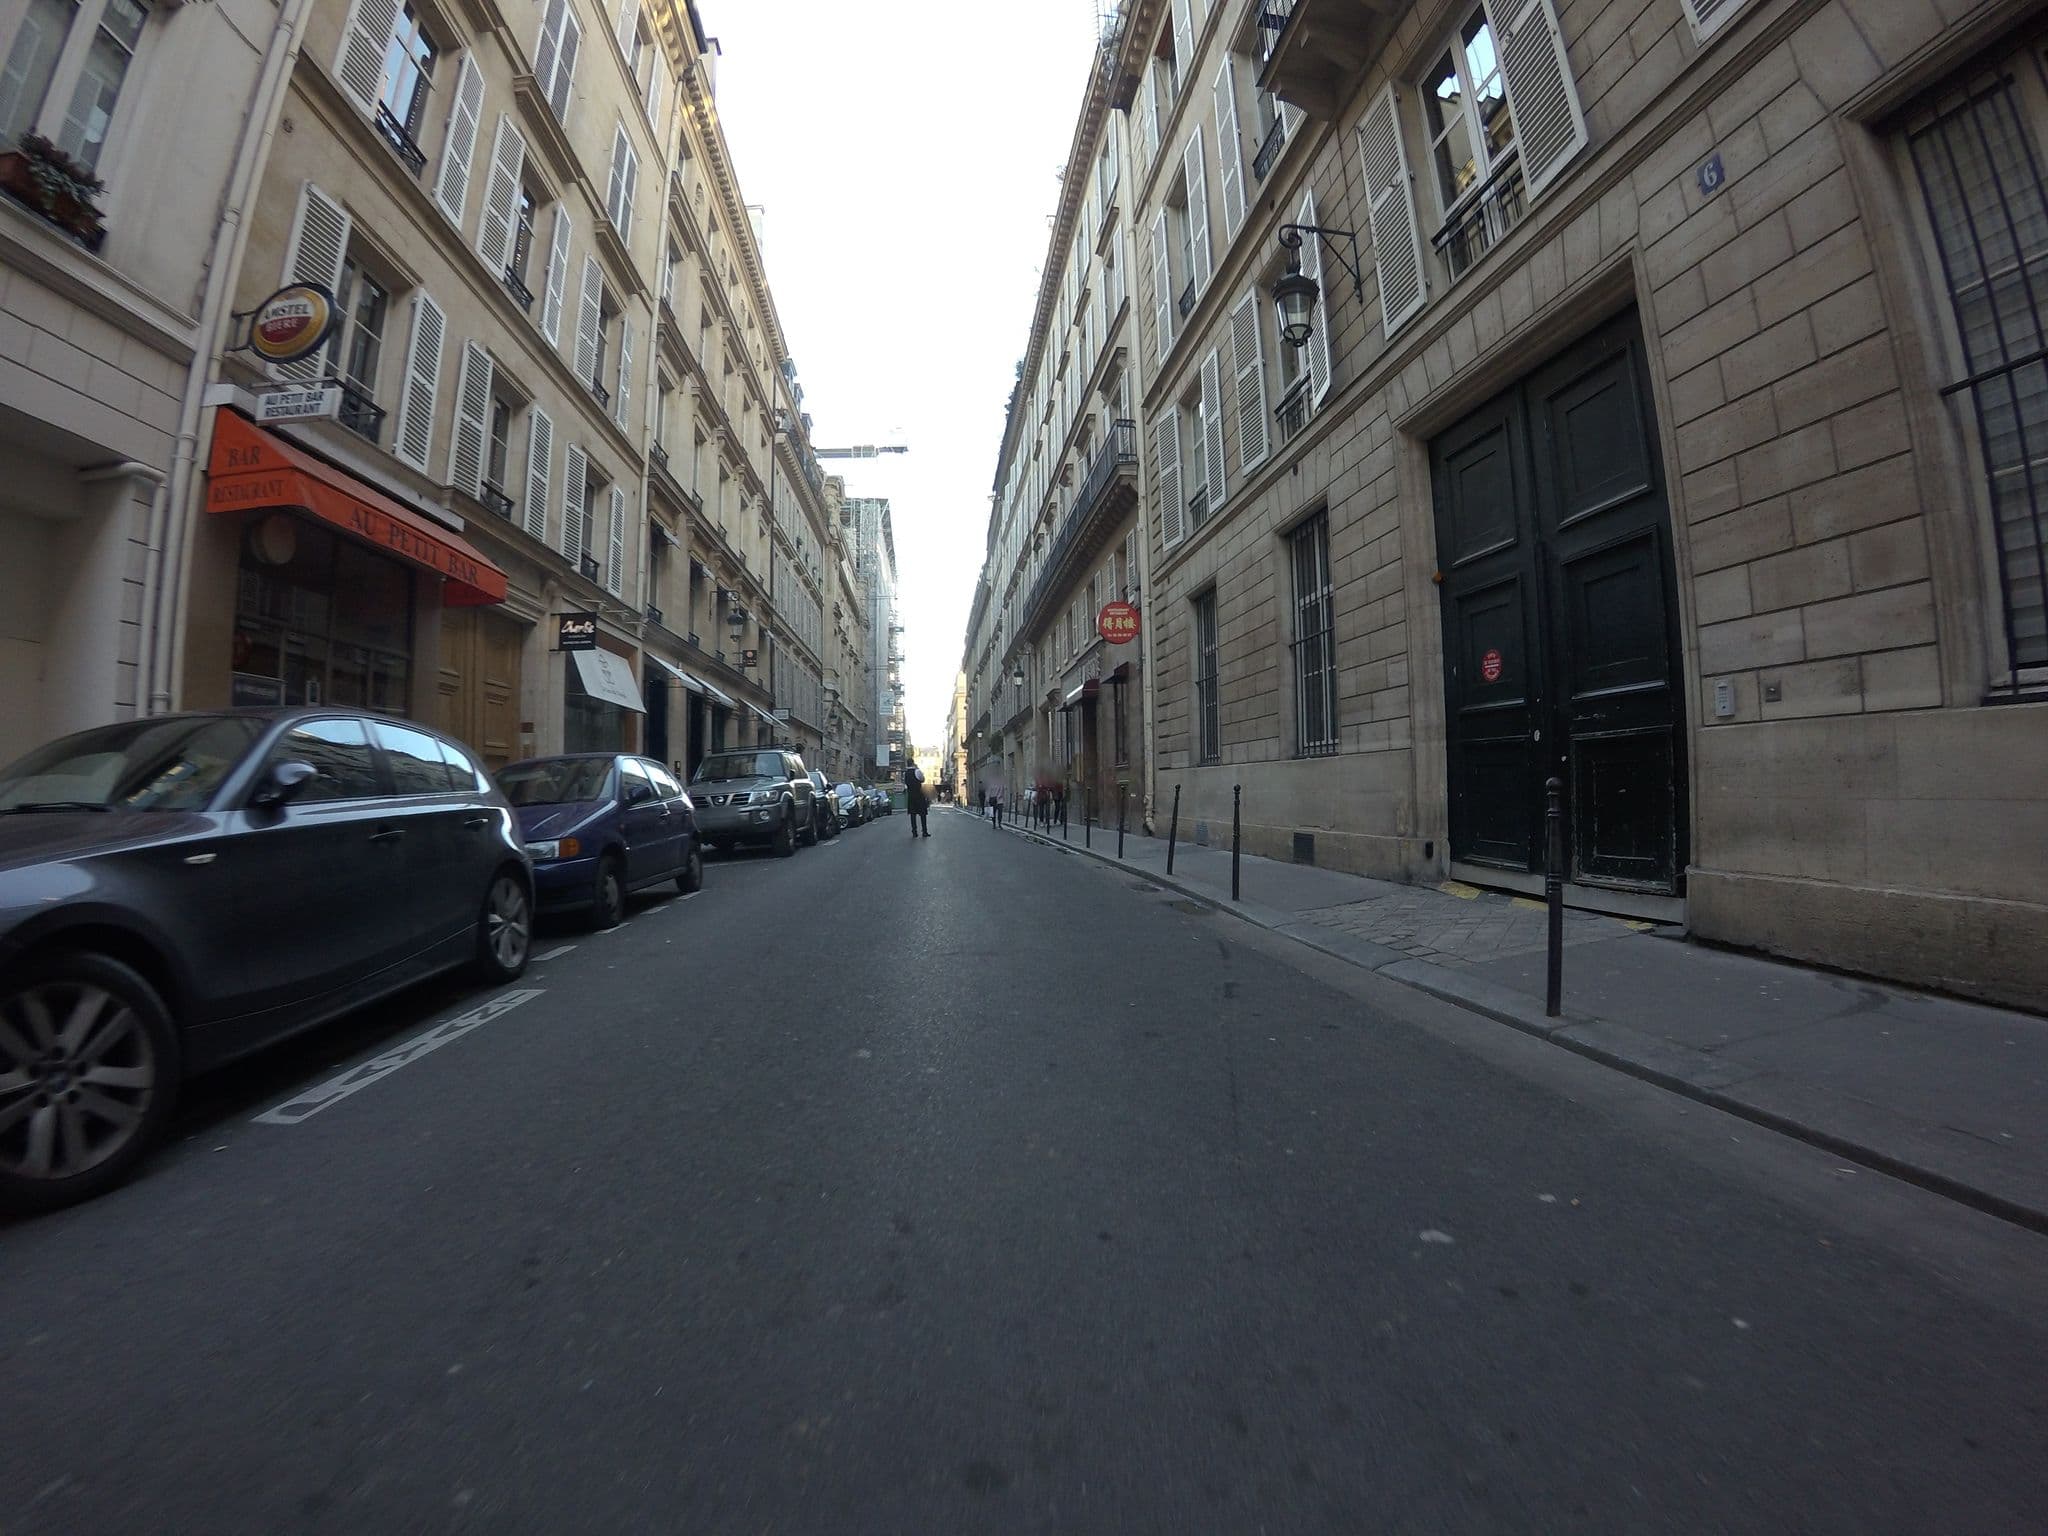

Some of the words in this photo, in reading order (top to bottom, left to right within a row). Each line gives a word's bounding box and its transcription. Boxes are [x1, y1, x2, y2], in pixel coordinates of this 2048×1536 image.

[1703, 161, 1718, 187] 6
[264, 303, 309, 320] AMSTEL
[265, 395, 279, 406] AU
[280, 393, 304, 405] PETIT
[305, 391, 325, 403] BAR
[264, 402, 322, 418] RESTAURANT
[228, 446, 261, 468] BAR
[350, 505, 376, 536] AU
[389, 523, 440, 565] PETIT
[447, 552, 478, 585] BAR
